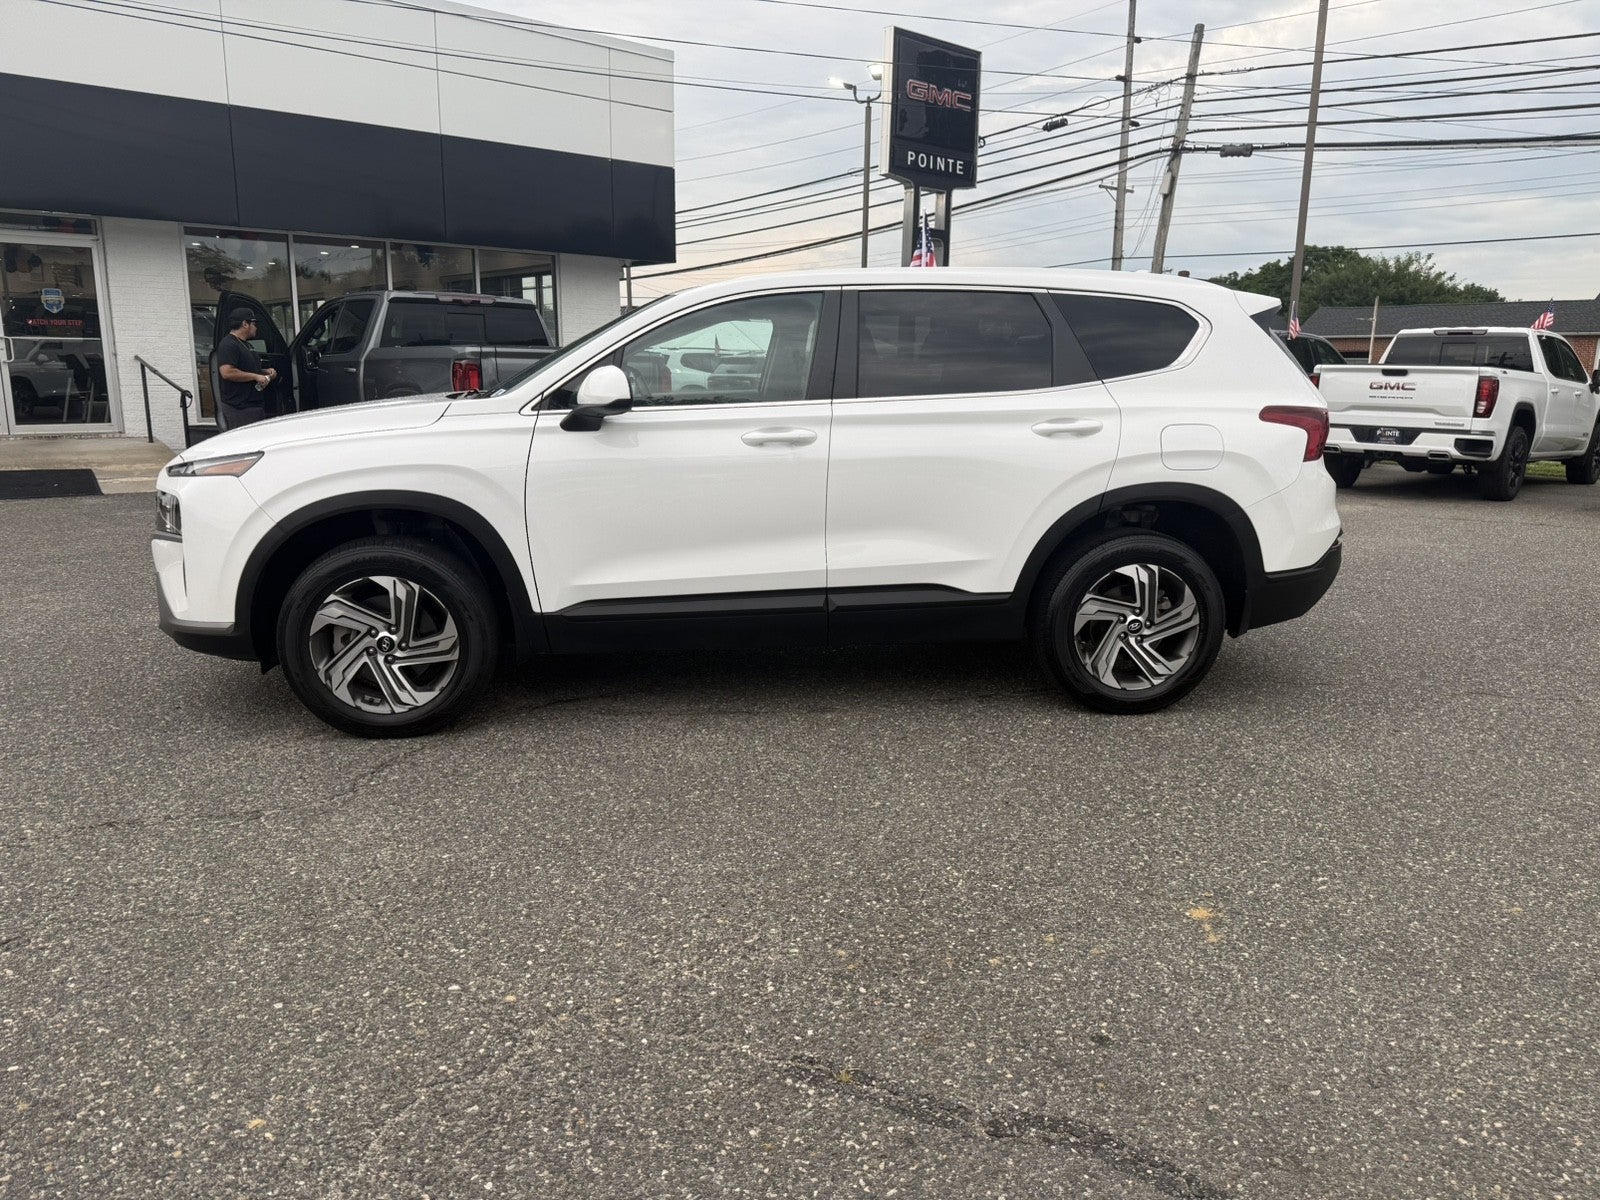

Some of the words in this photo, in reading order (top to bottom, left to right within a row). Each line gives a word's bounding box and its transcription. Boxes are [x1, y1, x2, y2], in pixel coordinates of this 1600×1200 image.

[907, 79, 972, 112] GMC
[907, 151, 964, 174] POINTE
[1369, 382, 1416, 391] GMC
